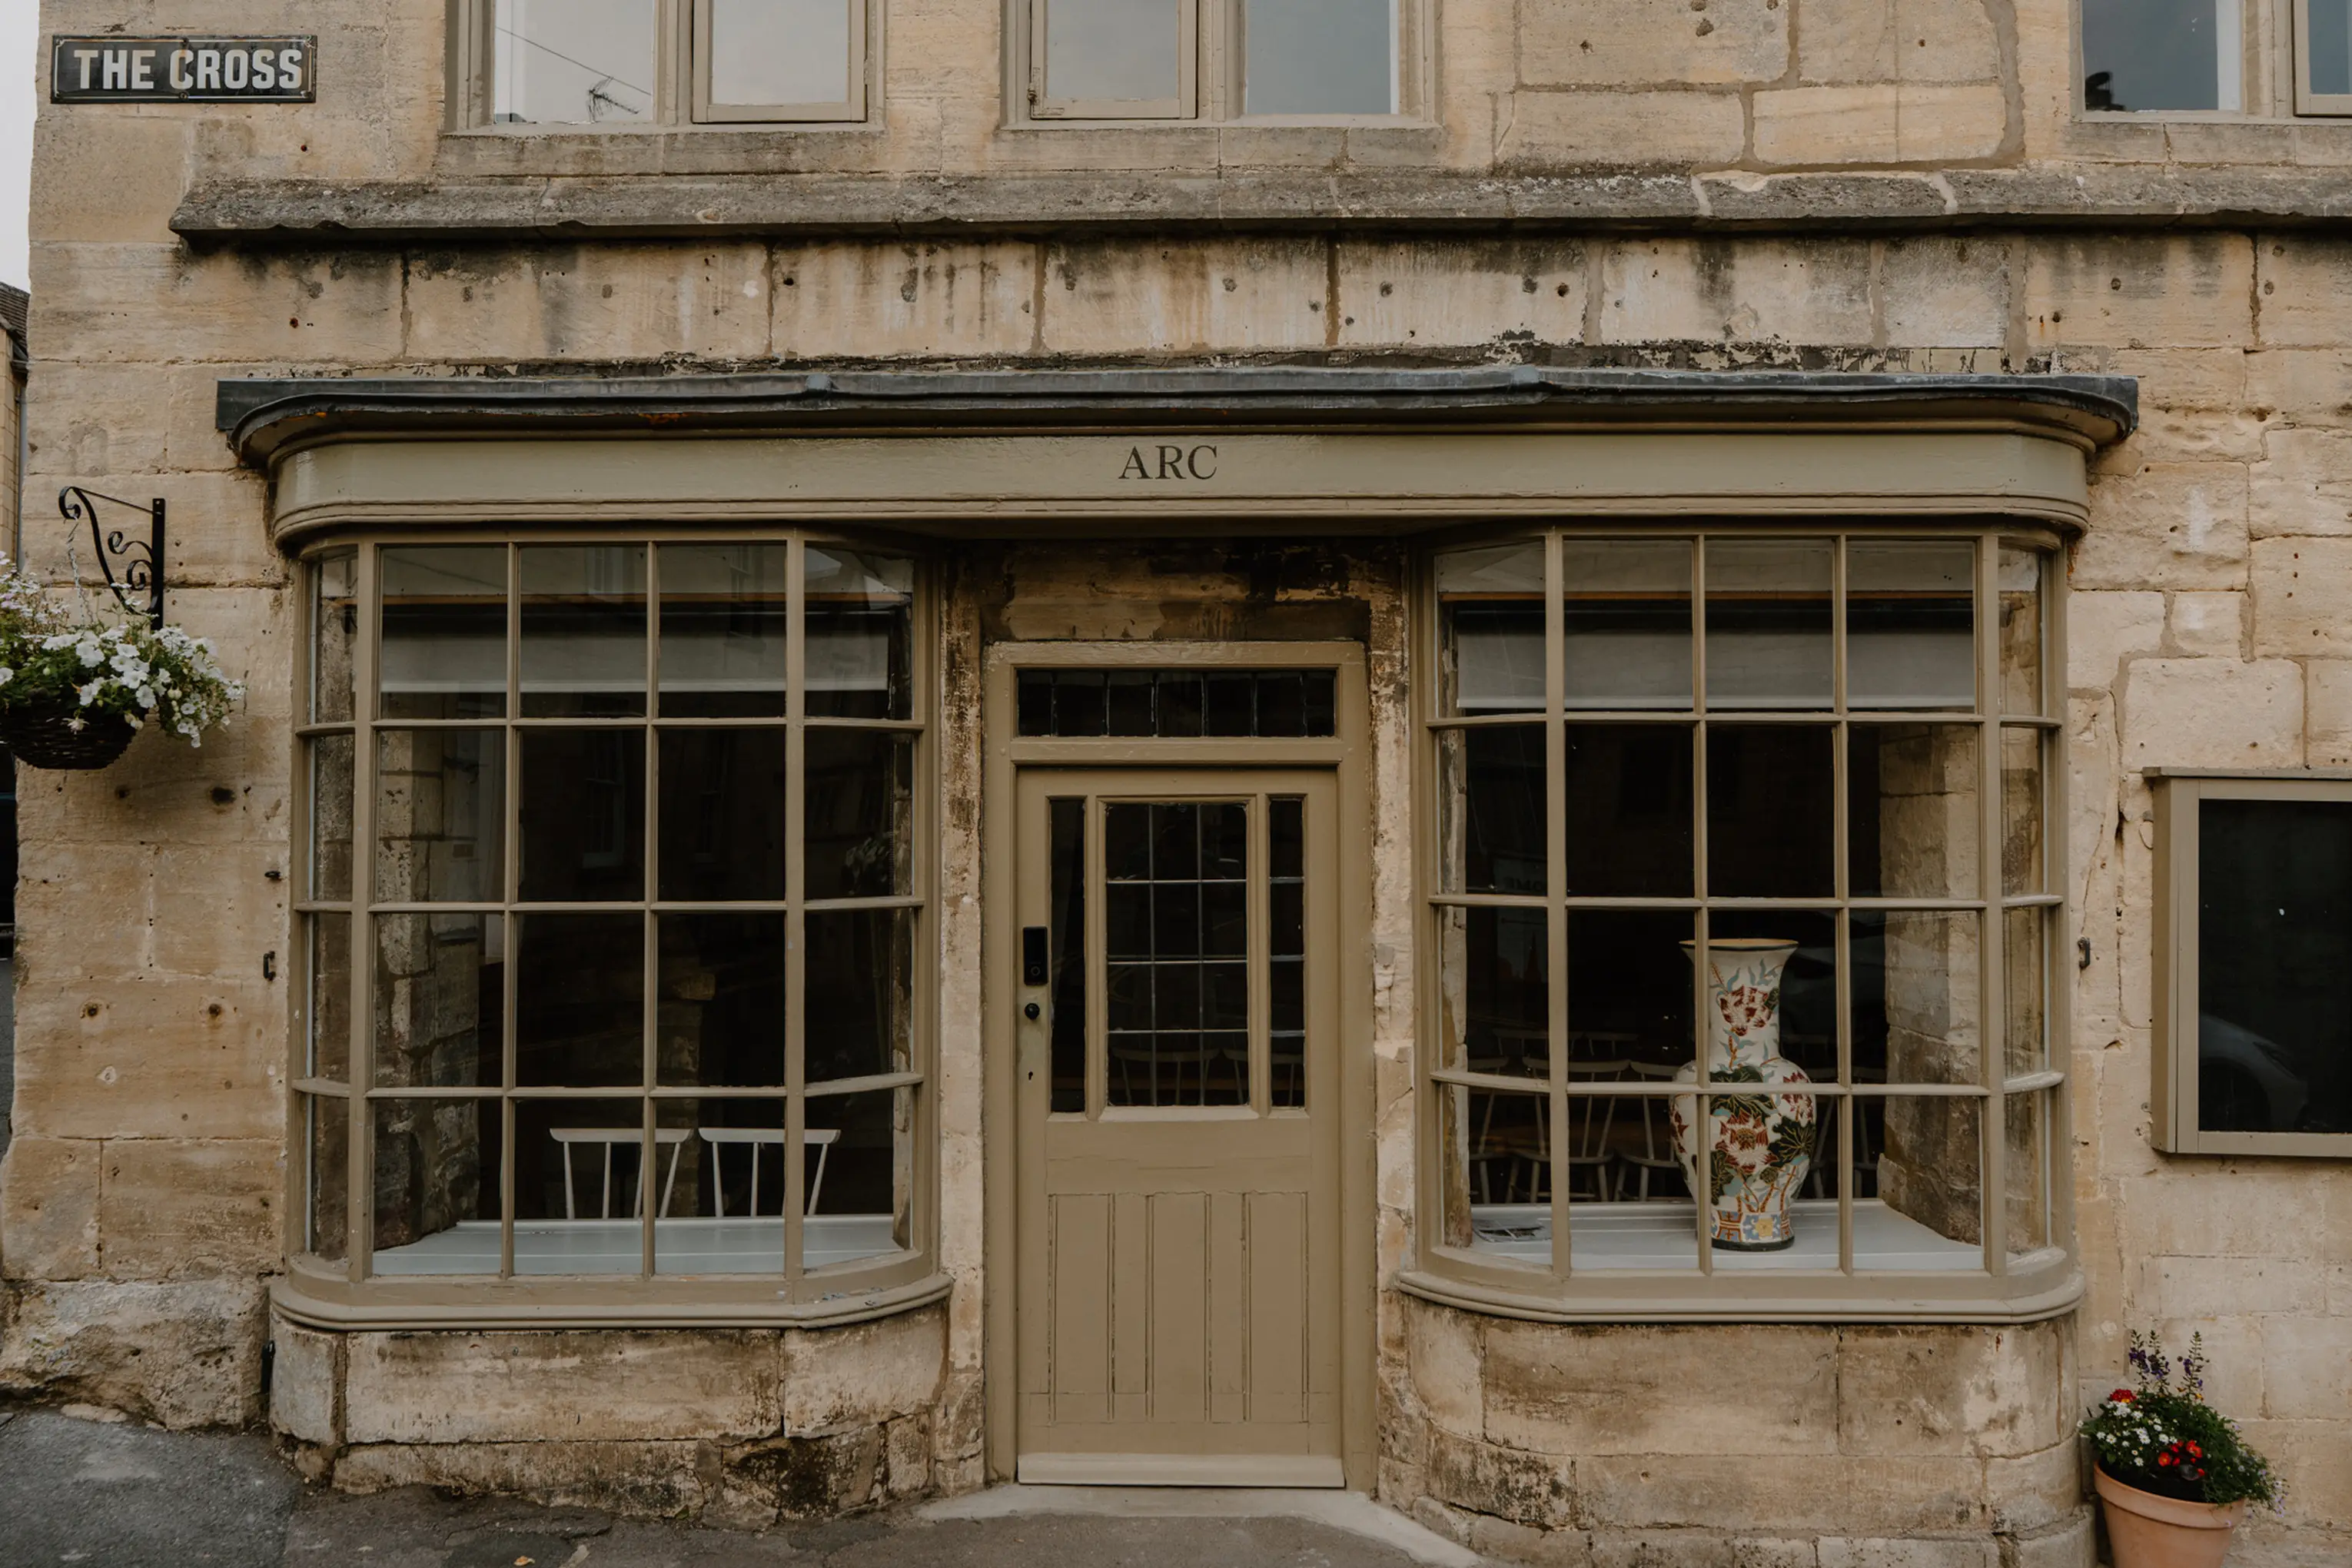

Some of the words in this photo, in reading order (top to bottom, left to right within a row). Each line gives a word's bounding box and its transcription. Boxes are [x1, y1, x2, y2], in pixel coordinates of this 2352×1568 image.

[74, 49, 156, 90] THE
[169, 48, 303, 90] CROSS
[1118, 445, 1218, 480] ARC
